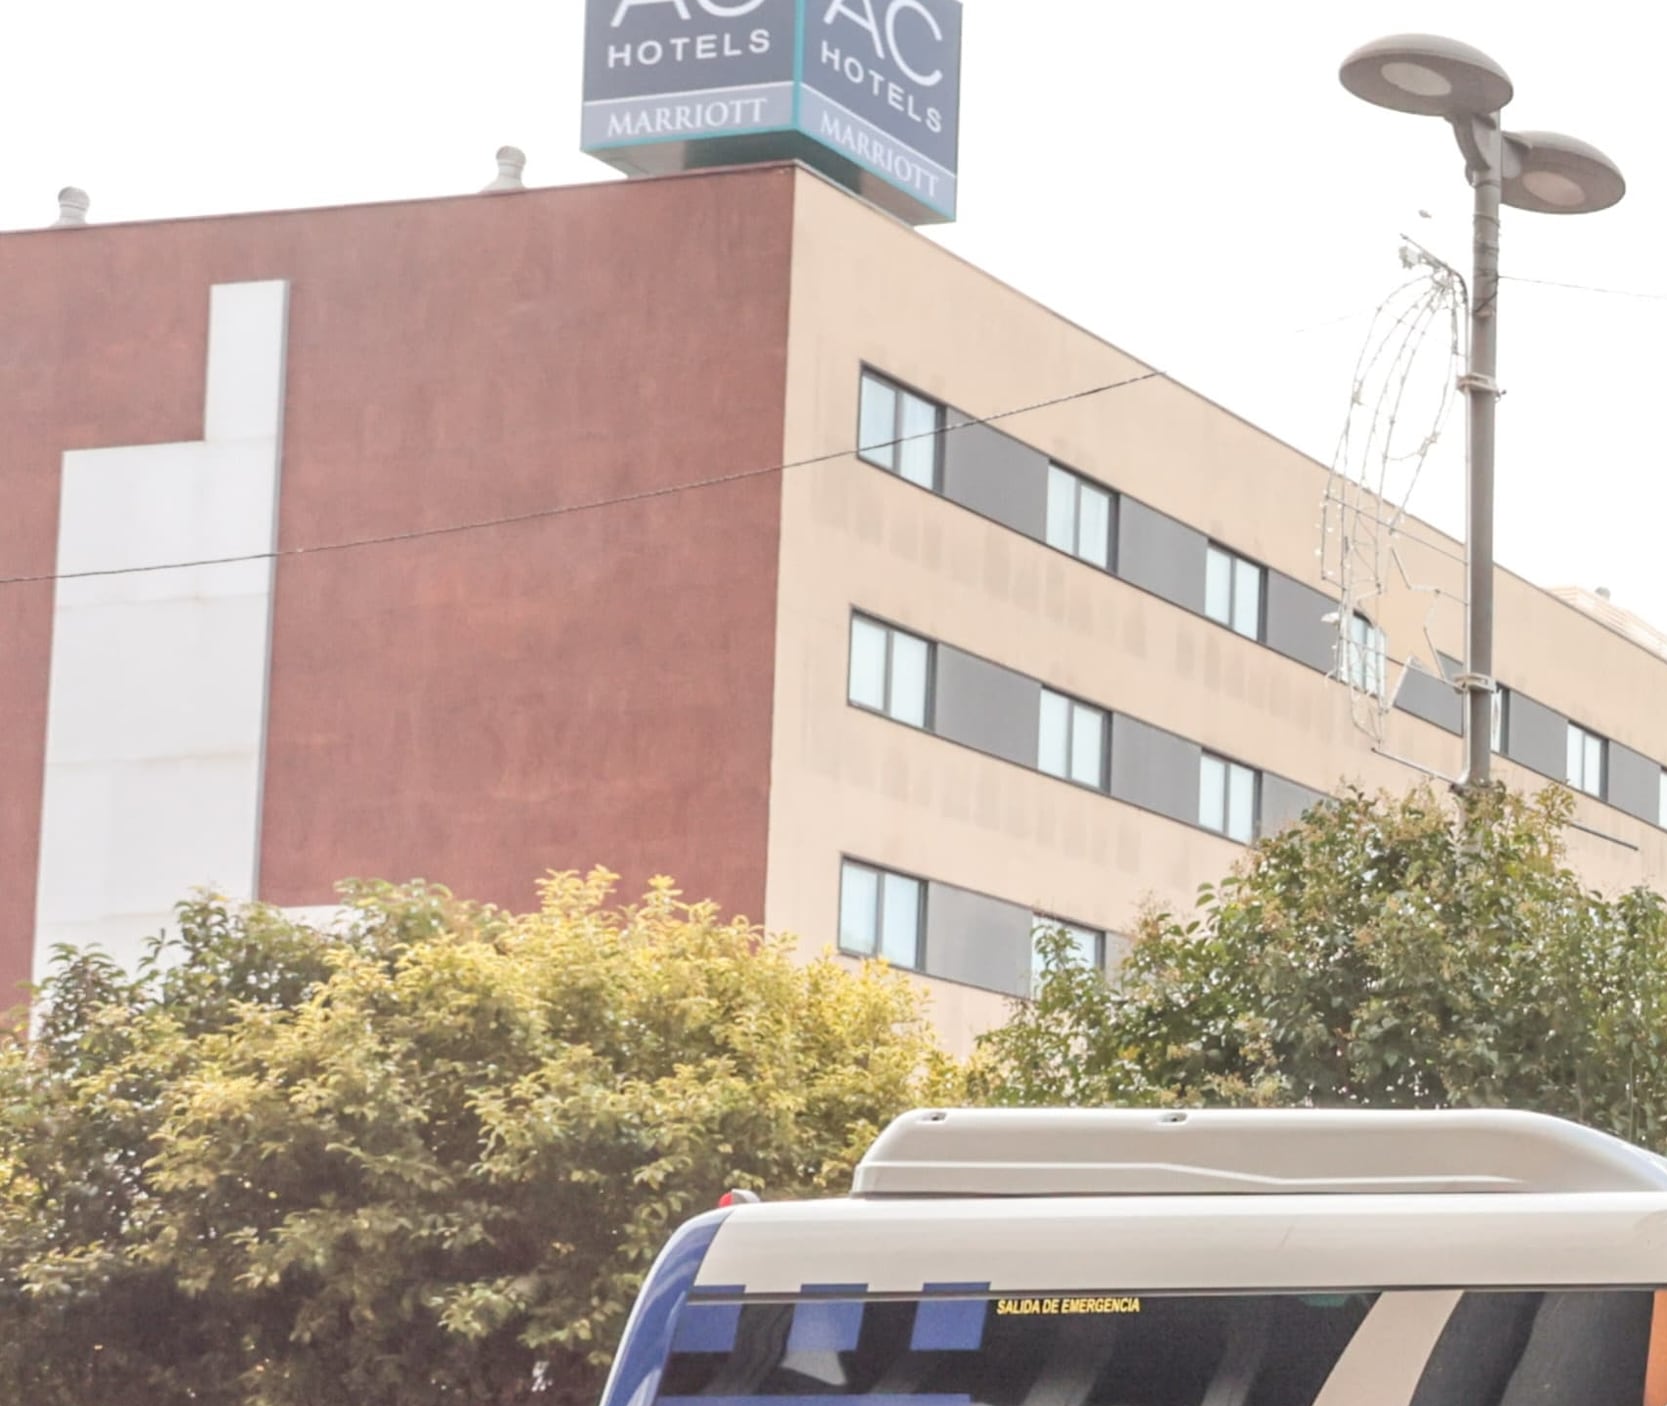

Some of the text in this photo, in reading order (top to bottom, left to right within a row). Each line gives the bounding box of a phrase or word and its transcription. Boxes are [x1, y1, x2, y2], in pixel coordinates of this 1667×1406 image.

[608, 29, 770, 68] HOTELS
[820, 40, 943, 133] HOTELS
[607, 98, 768, 137] MARRIOTT
[820, 110, 941, 200] MARRIOTT
[996, 1297, 1141, 1315] SALIDA DE EMERGENCIA
